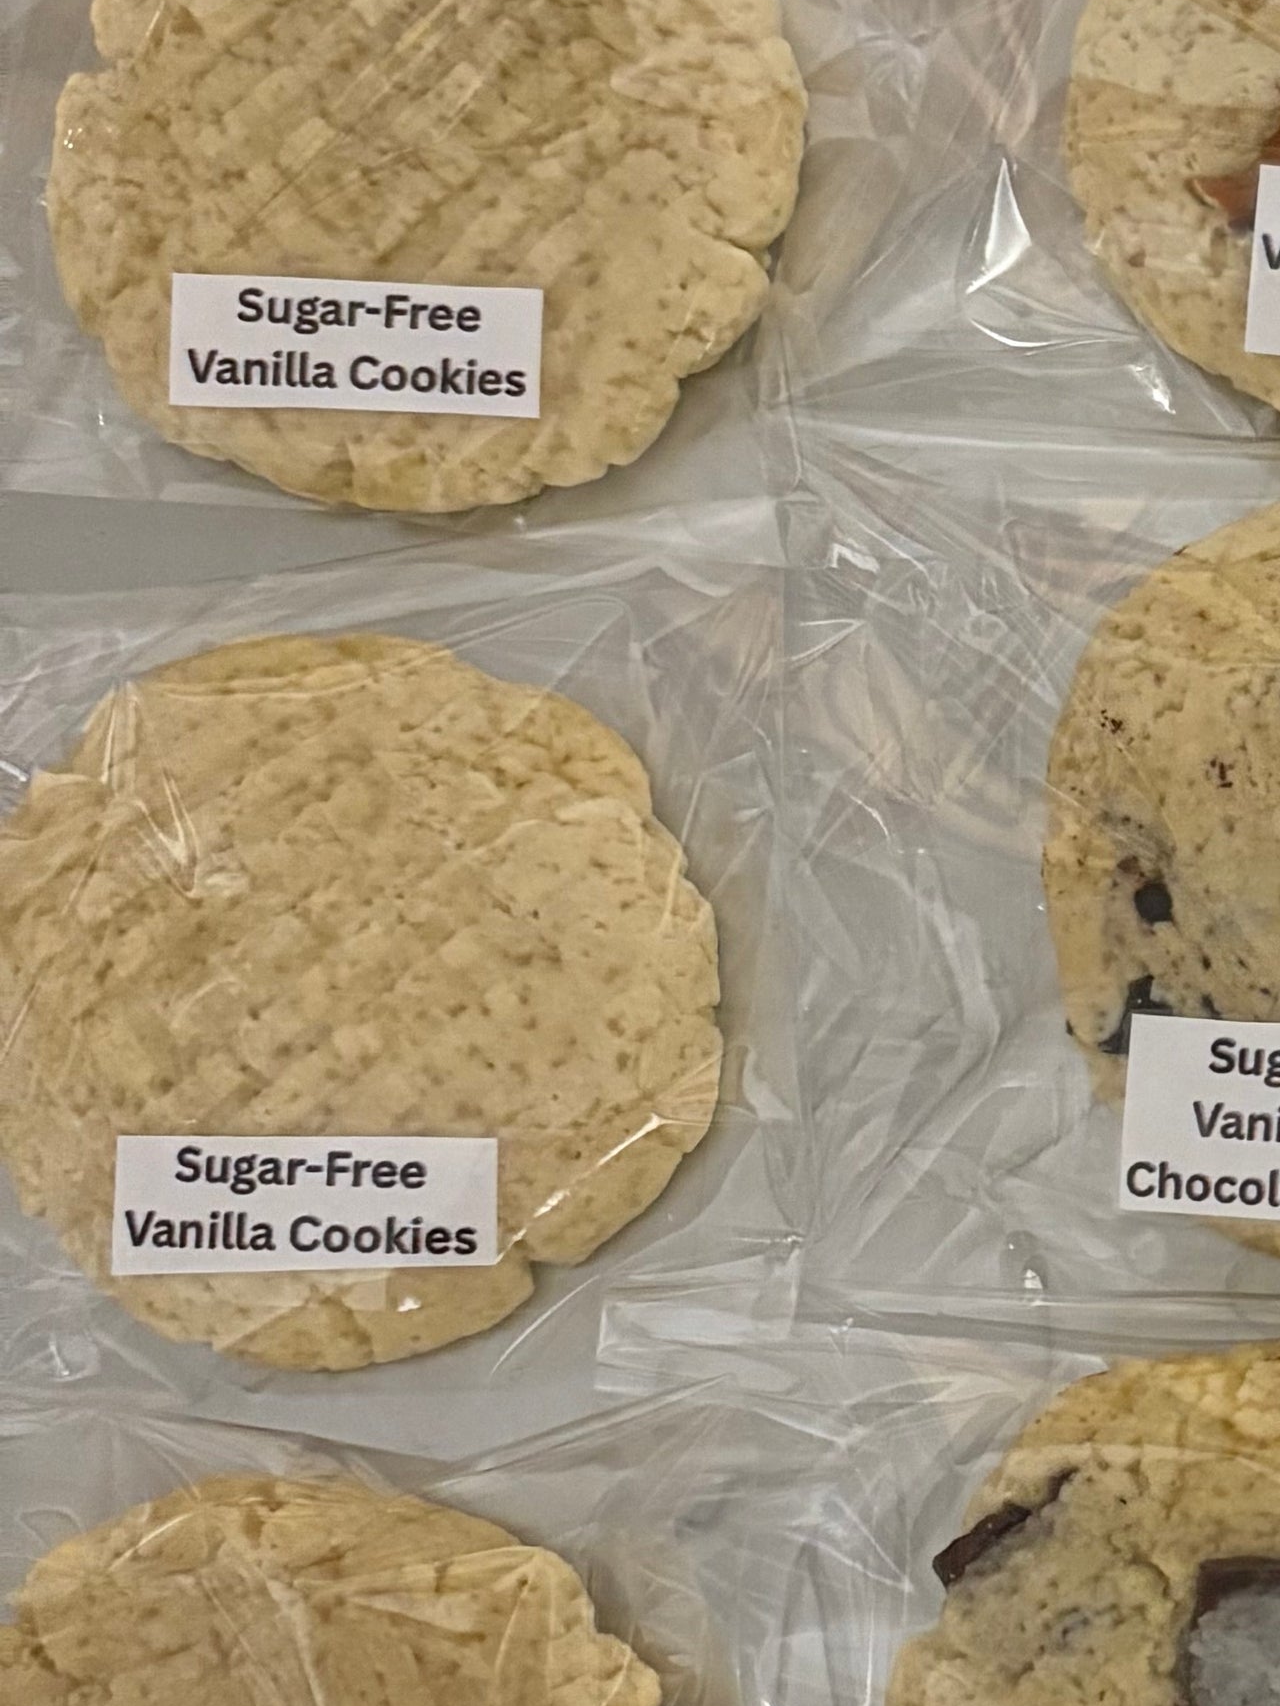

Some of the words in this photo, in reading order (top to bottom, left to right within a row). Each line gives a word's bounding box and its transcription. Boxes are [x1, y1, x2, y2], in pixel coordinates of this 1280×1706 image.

[236, 287, 482, 335] Sugar-Free
[187, 348, 338, 389] Vanilla
[349, 354, 527, 398] Cookies
[174, 1145, 427, 1196] Sugar-Free
[124, 1209, 277, 1252] Vanilla
[289, 1215, 478, 1256] Cookies
